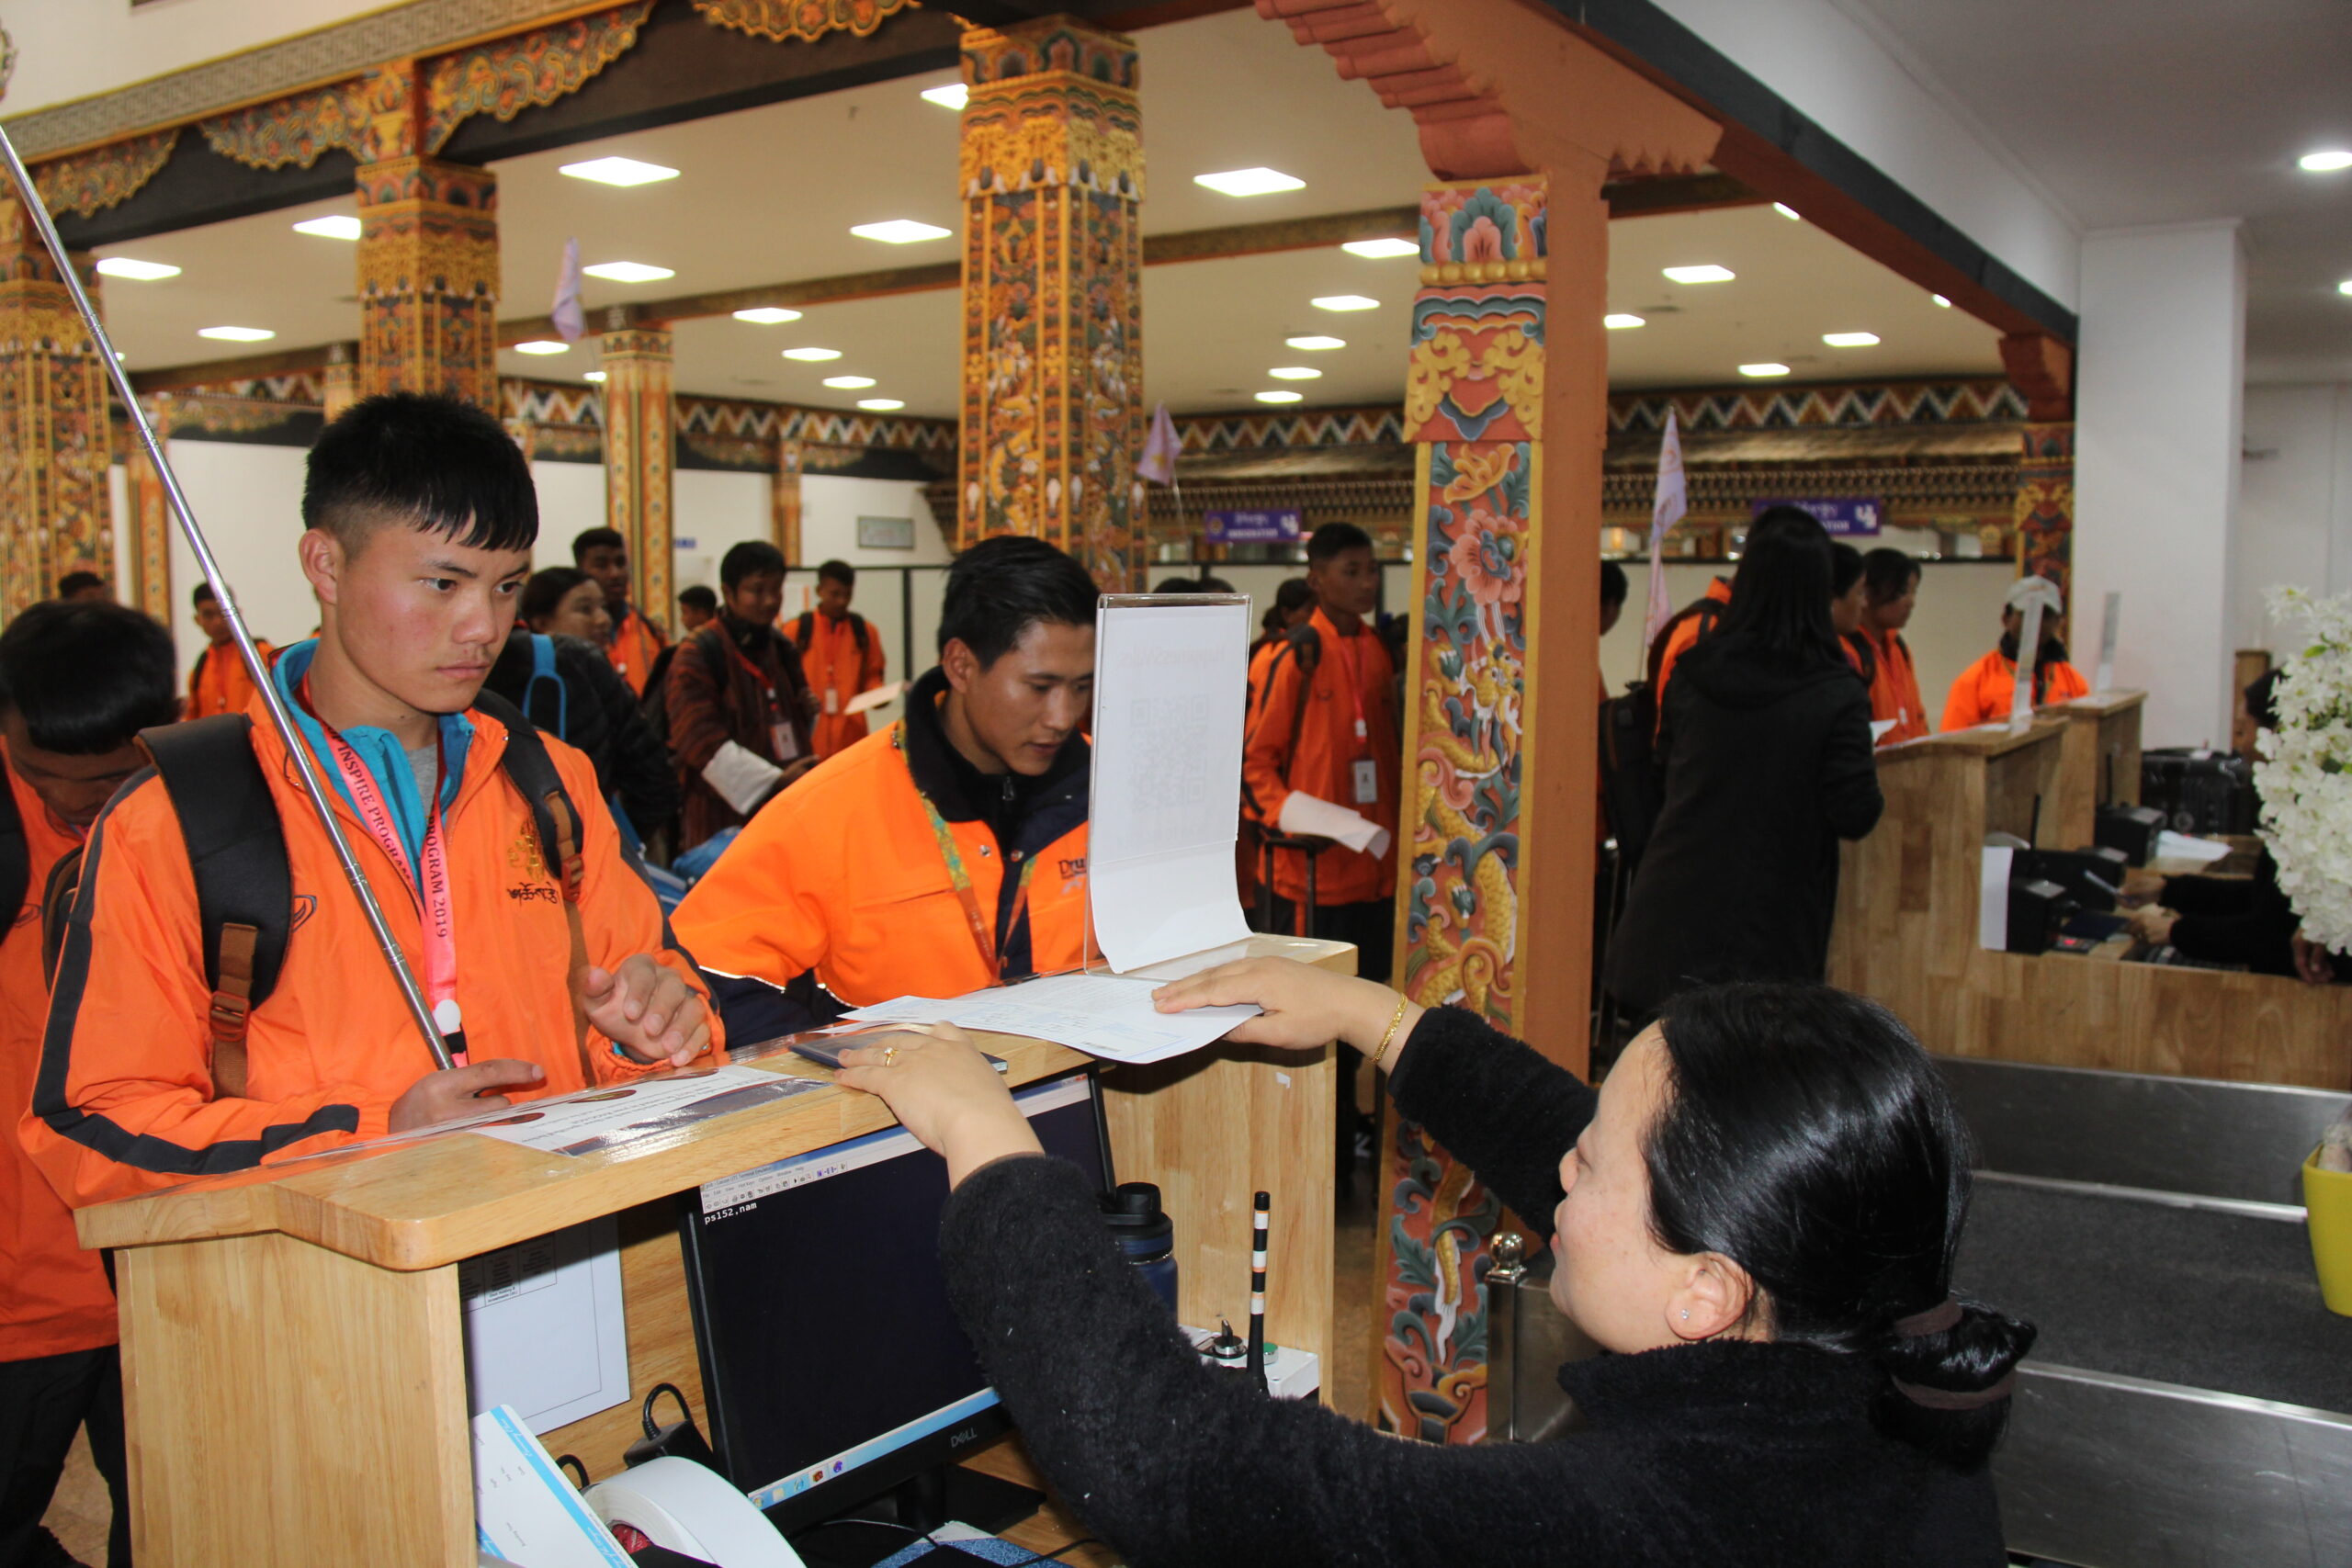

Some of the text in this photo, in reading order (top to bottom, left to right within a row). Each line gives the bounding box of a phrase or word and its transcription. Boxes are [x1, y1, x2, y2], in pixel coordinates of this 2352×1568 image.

[337, 745, 375, 806] INSPIRE
[425, 815, 447, 938] PROGRAM 2019
[1058, 852, 1088, 875] Dru
[950, 1427, 978, 1449] DELL
